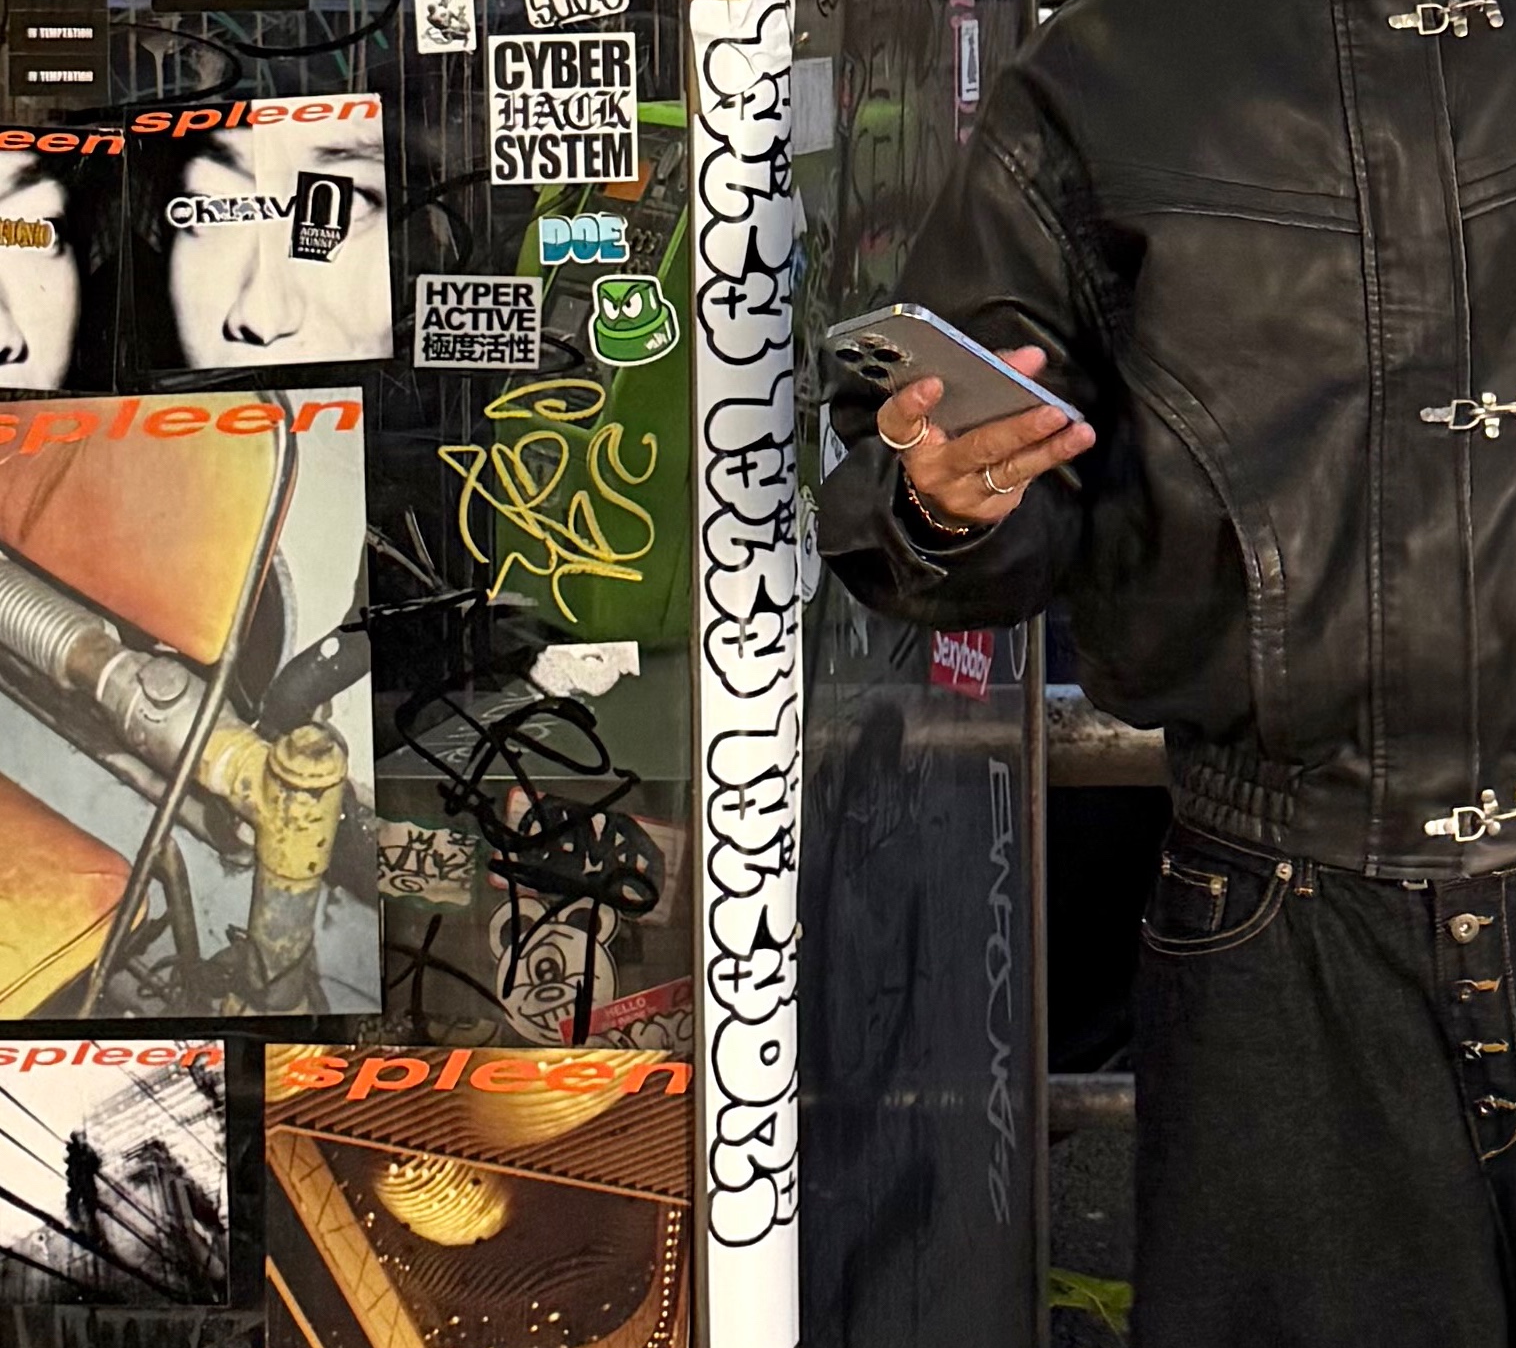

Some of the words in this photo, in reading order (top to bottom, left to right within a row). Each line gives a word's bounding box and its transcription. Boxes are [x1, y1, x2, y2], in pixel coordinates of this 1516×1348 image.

[494, 40, 631, 90] CYBER
[130, 99, 381, 138] spleen
[494, 89, 632, 131] HACK
[494, 133, 633, 180] SYSTEM
[541, 214, 627, 262] DOE
[426, 282, 534, 307] HYPER
[422, 308, 536, 331] ACTIVE
[422, 332, 536, 363] 極度活性
[282, 1049, 693, 1100] spleen
